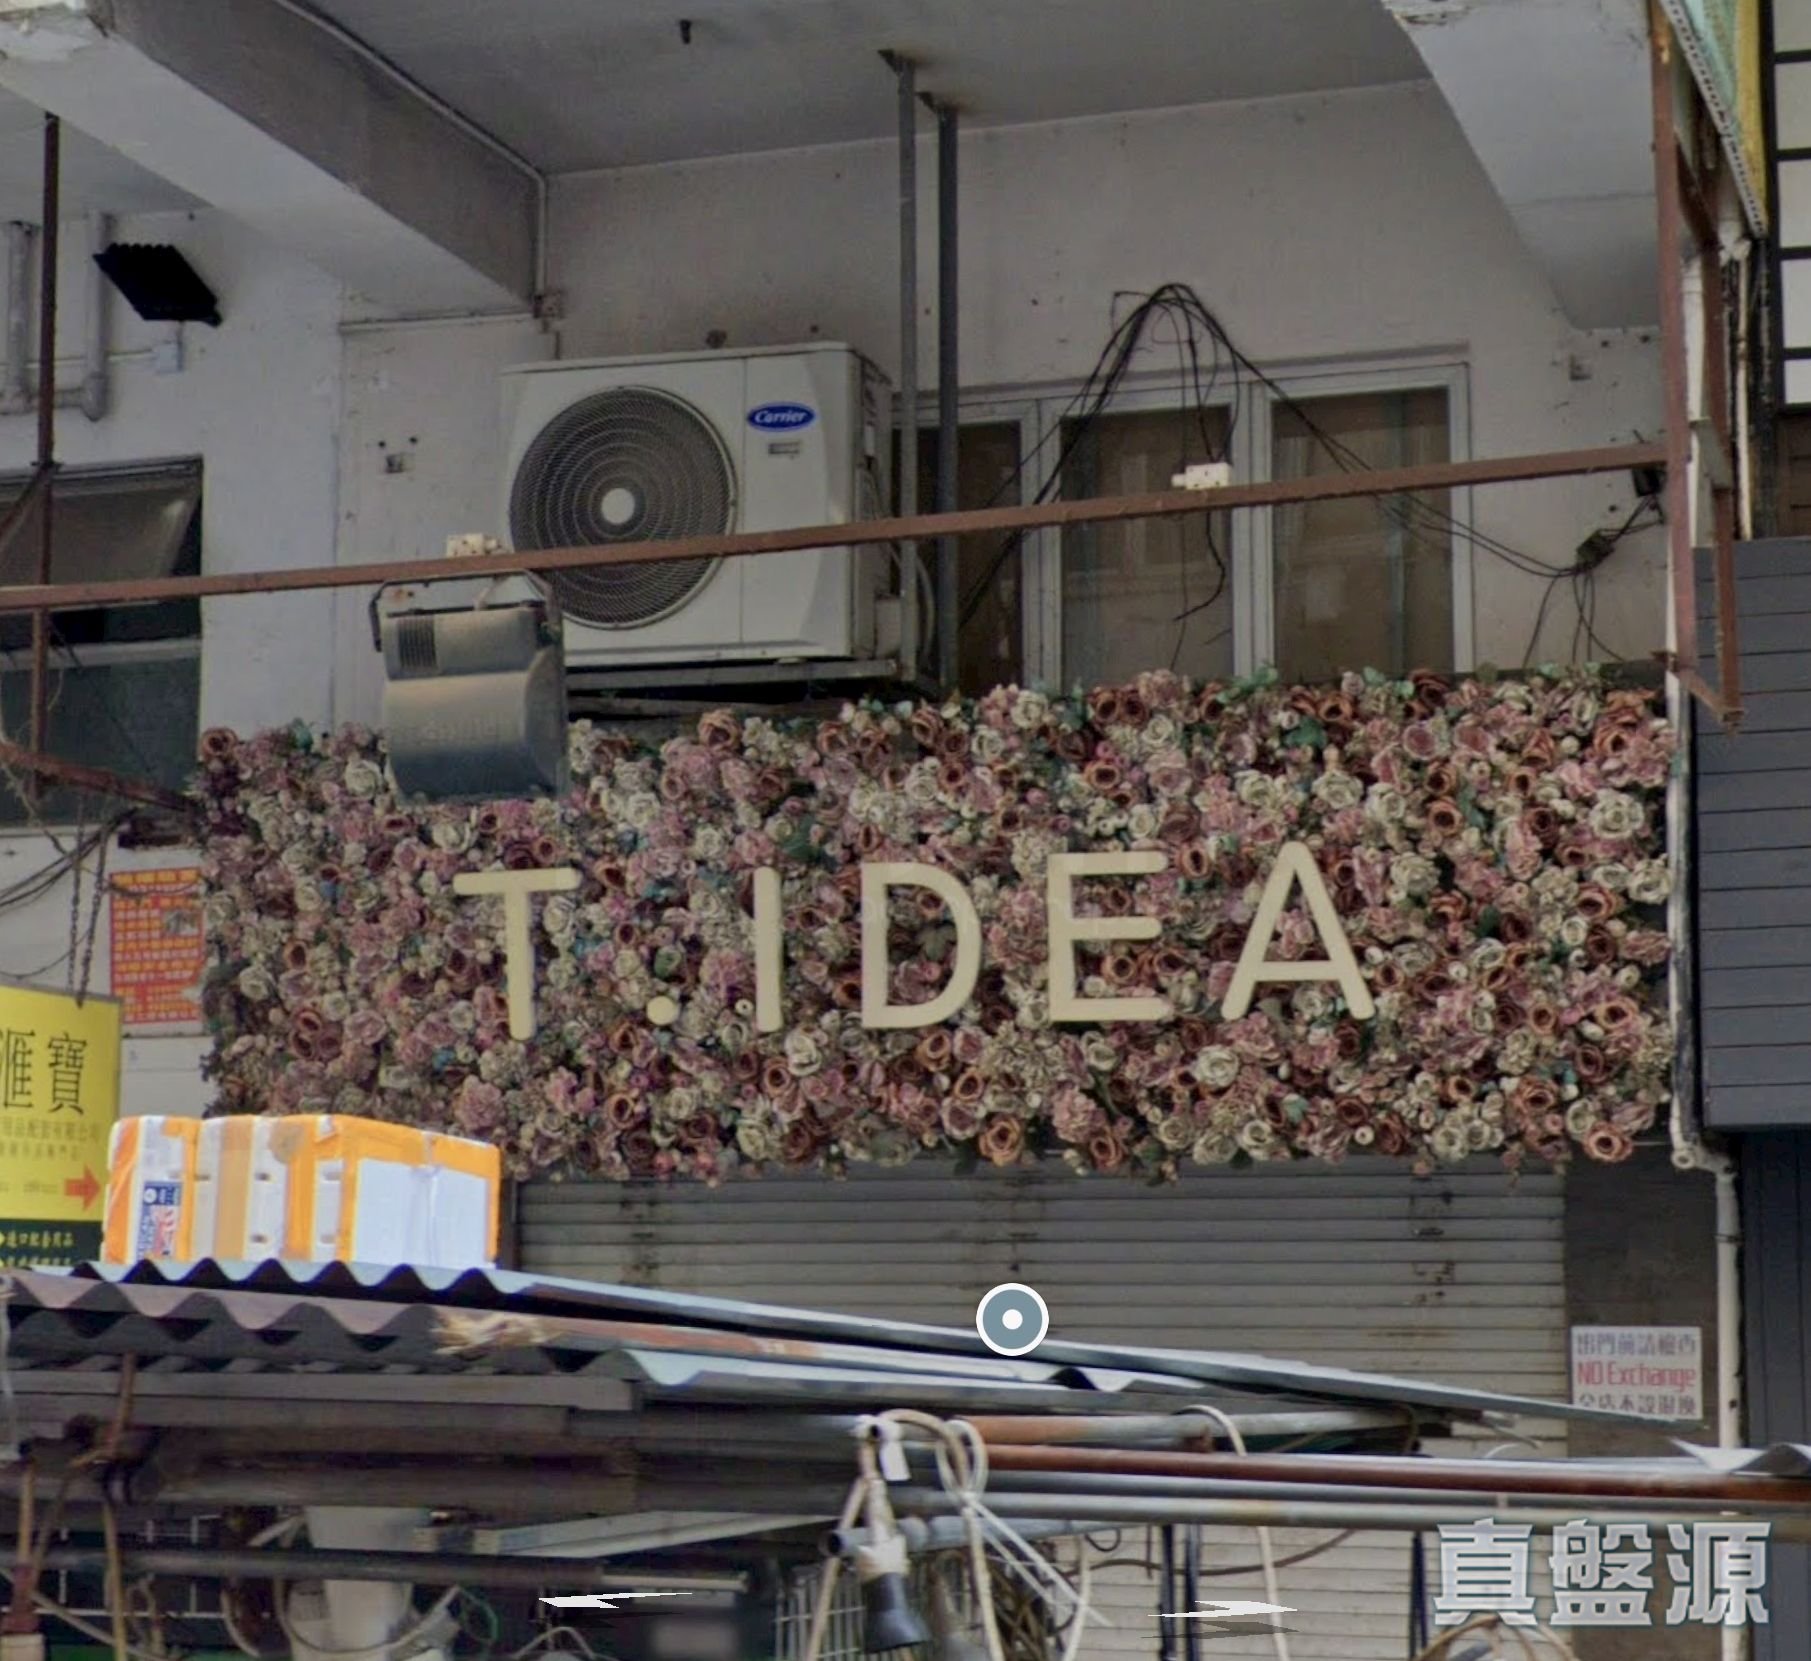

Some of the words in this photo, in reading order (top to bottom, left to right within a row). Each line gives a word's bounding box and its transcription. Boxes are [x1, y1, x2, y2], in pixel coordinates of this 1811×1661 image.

[754, 410, 808, 423] Carrier
[1577, 1360, 1603, 1386] NO
[1607, 1361, 1697, 1393] Exchange
